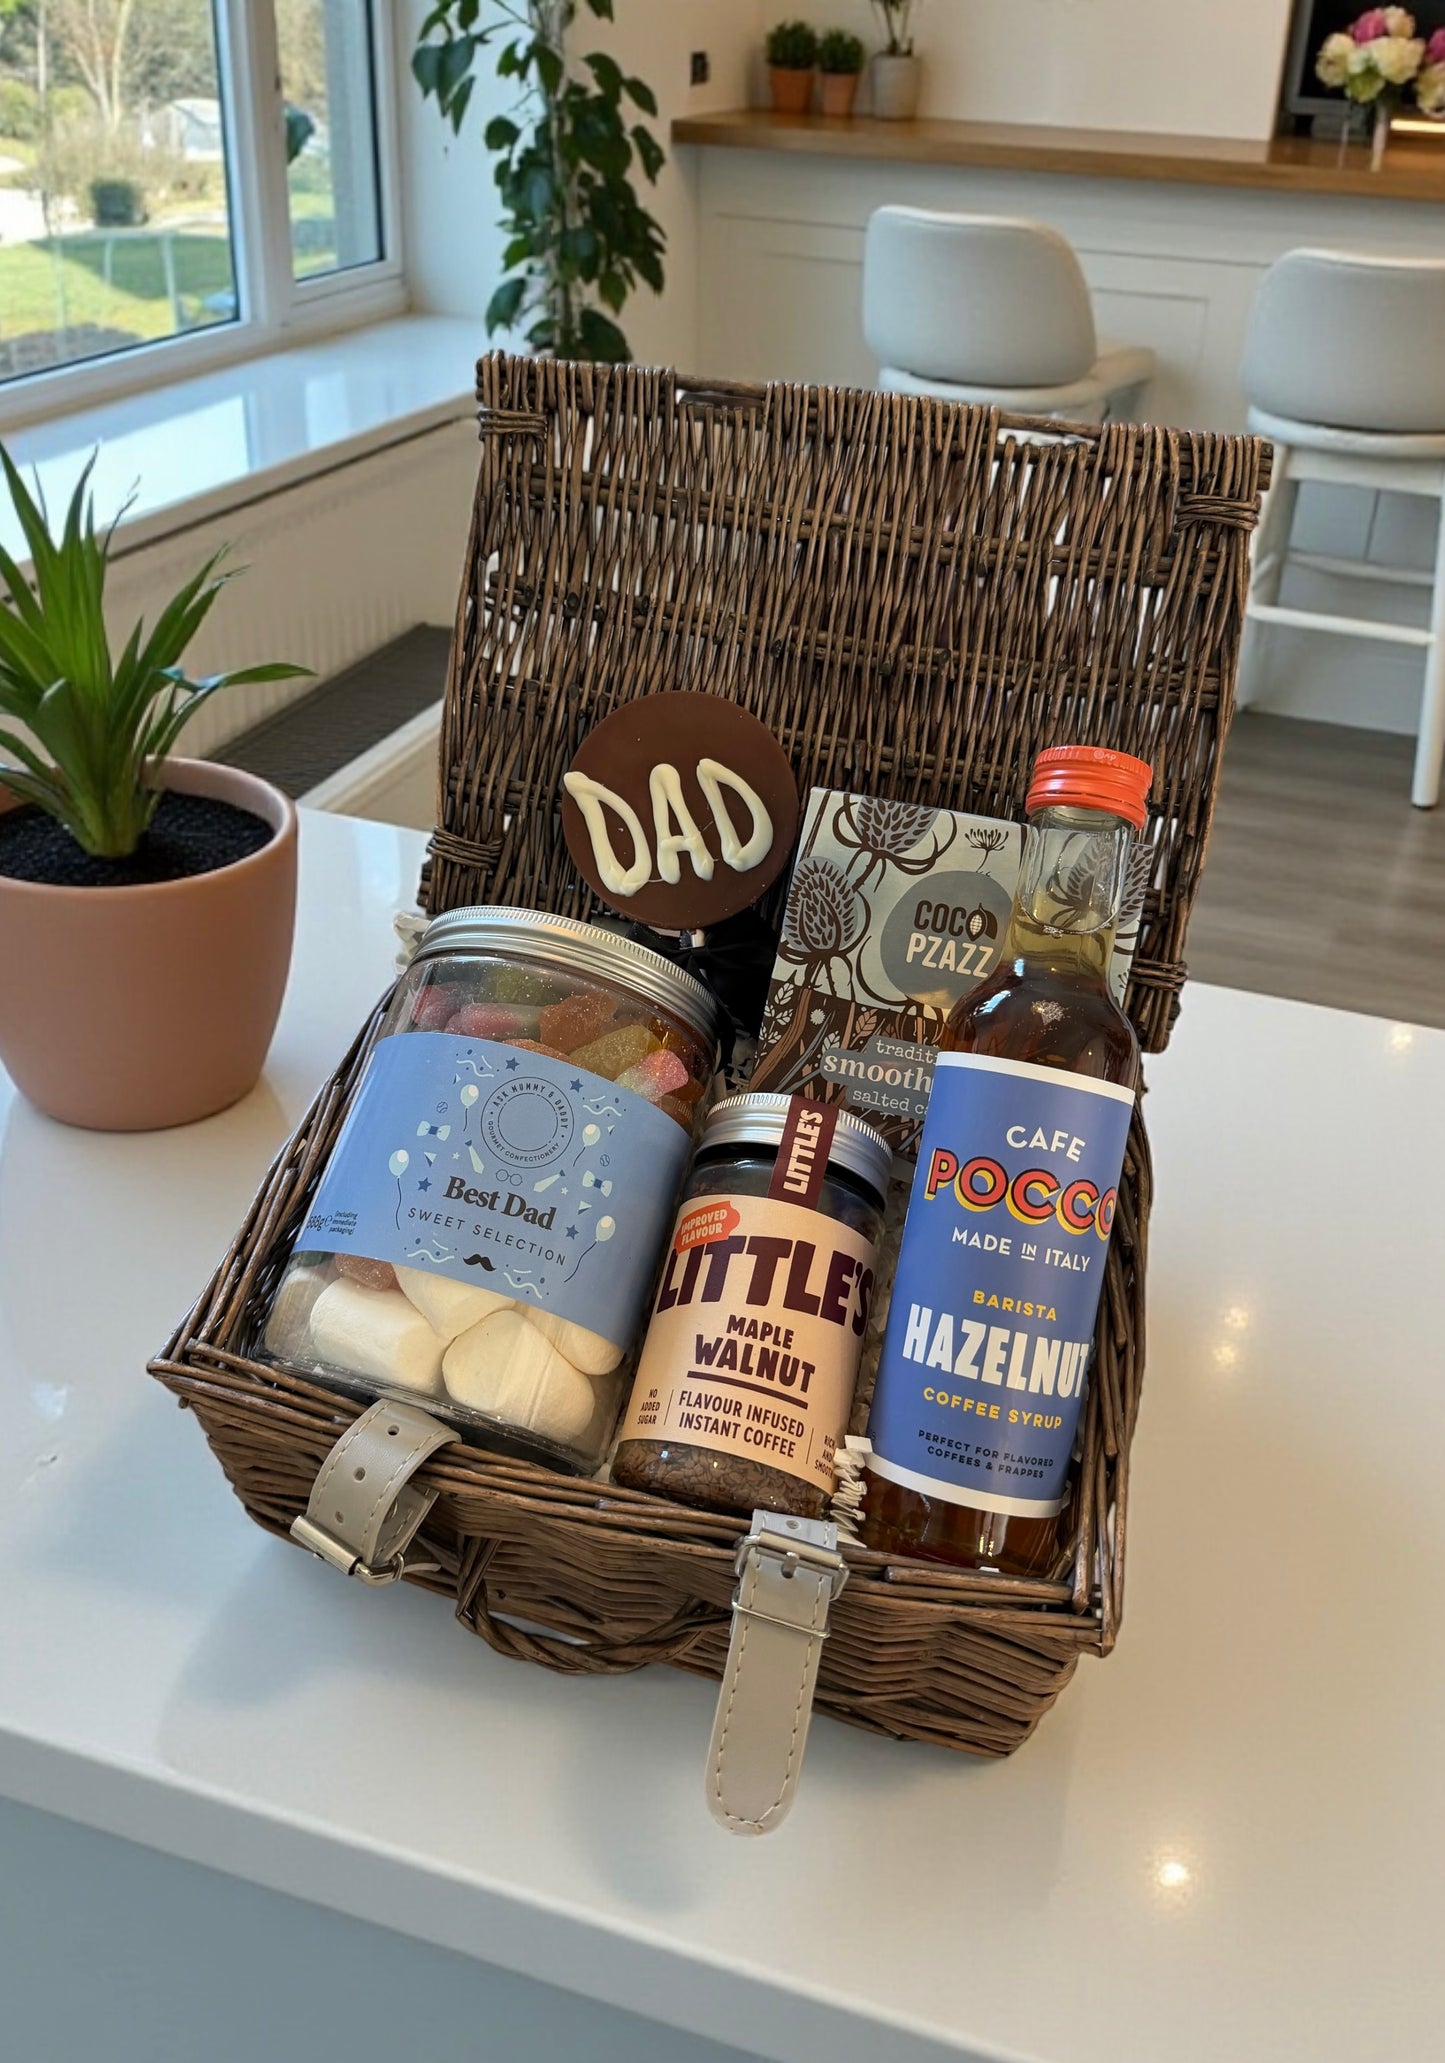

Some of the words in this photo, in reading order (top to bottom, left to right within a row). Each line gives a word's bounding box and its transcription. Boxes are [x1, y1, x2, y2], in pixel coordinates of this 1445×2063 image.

[563, 758, 773, 897] DAD
[914, 900, 997, 941] COCO
[906, 932, 994, 978] PZAZZ
[493, 1091, 509, 1107] ASK
[511, 1083, 546, 1093] MUMMY
[554, 1099, 568, 1129] DADDY
[852, 1090, 910, 1112] salted
[488, 1120, 505, 1152] GOURMET
[505, 1142, 559, 1162] CONFECTIONERY
[783, 1109, 823, 1195] LITTLE'S
[1006, 1125, 1086, 1162] CAFE
[443, 1176, 500, 1211] Best
[501, 1192, 557, 1231] Dad
[924, 1147, 1118, 1241] POCCO
[407, 1207, 465, 1230] SWEET
[472, 1224, 566, 1266] SELECTION
[681, 1209, 728, 1235] IMPROVED
[681, 1222, 723, 1246] FLAVOUR
[952, 1226, 1012, 1256] MADE
[1021, 1242, 1037, 1260] IN
[1044, 1248, 1090, 1272] ITALY
[656, 1235, 875, 1337] LITTLE'S
[972, 1290, 1057, 1321] BARISTA
[726, 1315, 794, 1350] MAPLE
[902, 1303, 1090, 1398] HAZELNUT
[695, 1334, 816, 1393] WALNUT
[640, 1401, 660, 1411] ADDED
[649, 1389, 658, 1398] NO
[678, 1390, 743, 1418] FLAVOUR
[746, 1404, 805, 1438] INFUSED
[923, 1386, 1001, 1420] COFFEE
[1008, 1408, 1062, 1429] SYRUP
[637, 1414, 657, 1425] SUGAR
[678, 1412, 741, 1439] INSTANT
[743, 1427, 796, 1458] COFFEE
[918, 1429, 970, 1452] PERFECT
[975, 1446, 999, 1459] FOR
[1003, 1453, 1054, 1467] FLAVORED
[927, 1446, 981, 1467] COFFEES
[985, 1461, 993, 1471] &
[998, 1464, 1044, 1479] FRAPPES
